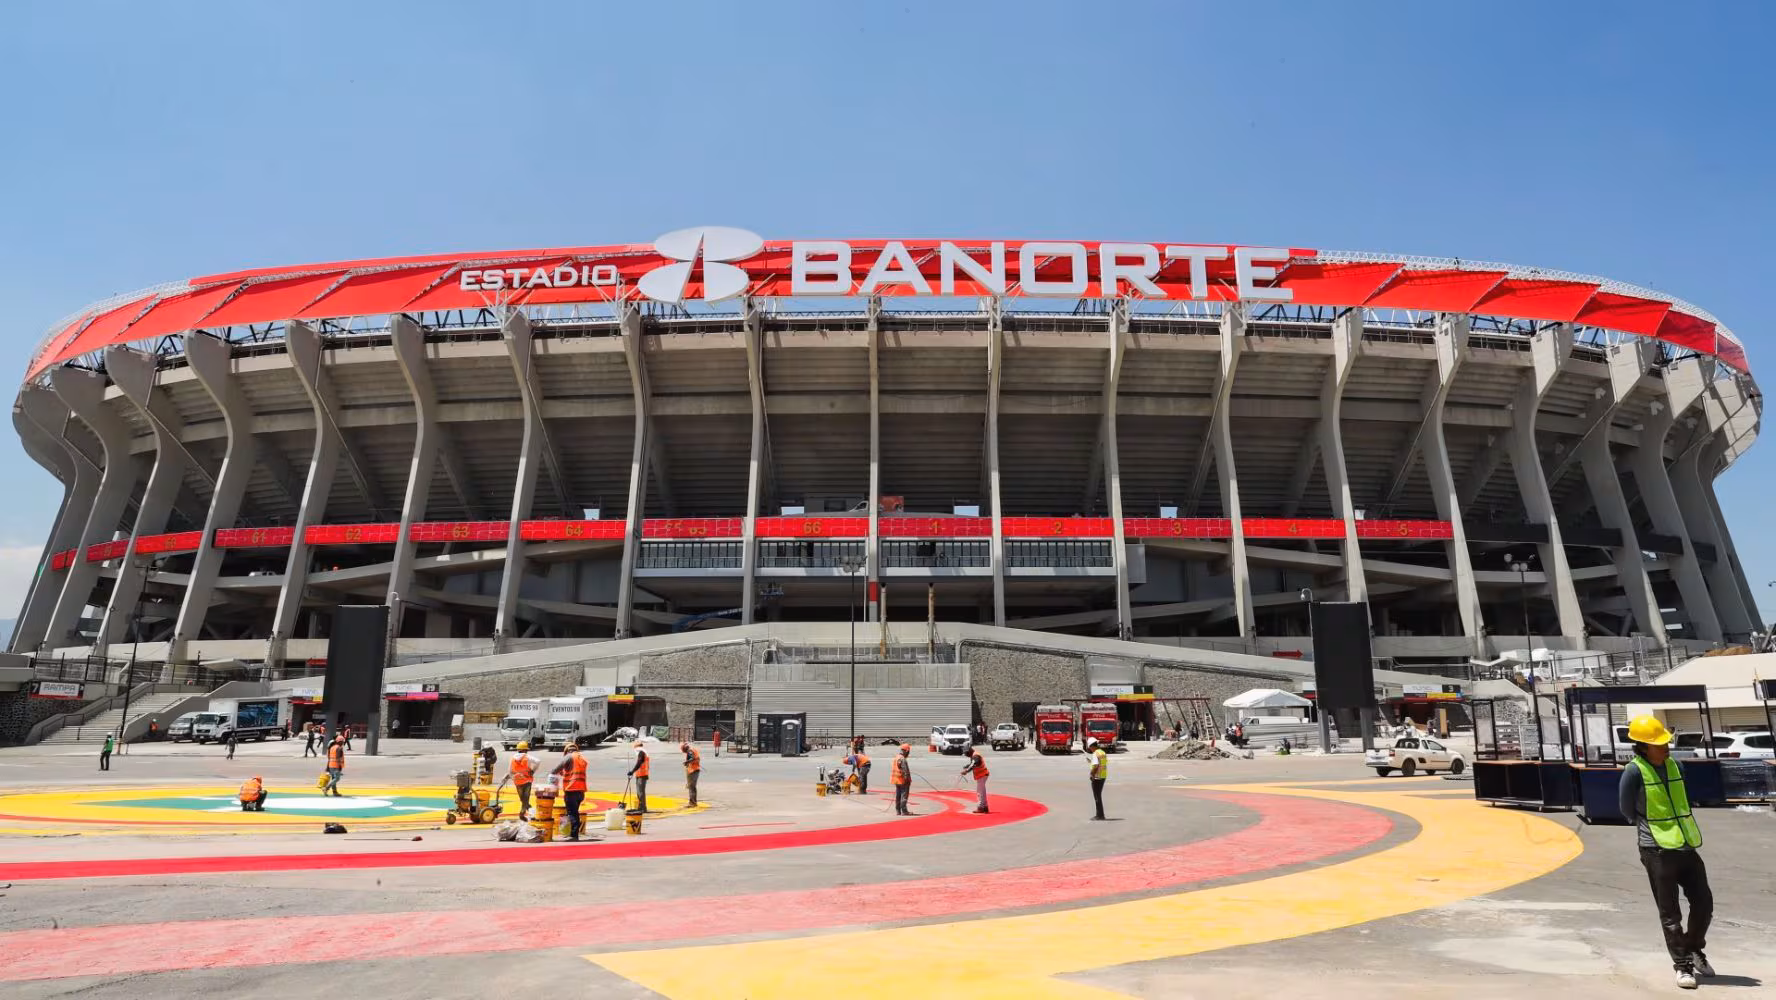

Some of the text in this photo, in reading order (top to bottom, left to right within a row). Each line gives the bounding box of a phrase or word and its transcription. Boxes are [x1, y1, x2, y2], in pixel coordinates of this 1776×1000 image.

[461, 240, 1294, 300] ESTADIO BANORTE
[453, 525, 470, 538] 63
[565, 524, 583, 537] 64
[803, 521, 822, 534] 66
[931, 520, 940, 534] 1
[1054, 521, 1063, 534] 2
[1174, 521, 1183, 535] 3
[1288, 523, 1297, 535] 4
[1400, 523, 1409, 536] 5
[32, 683, 39, 693] 7
